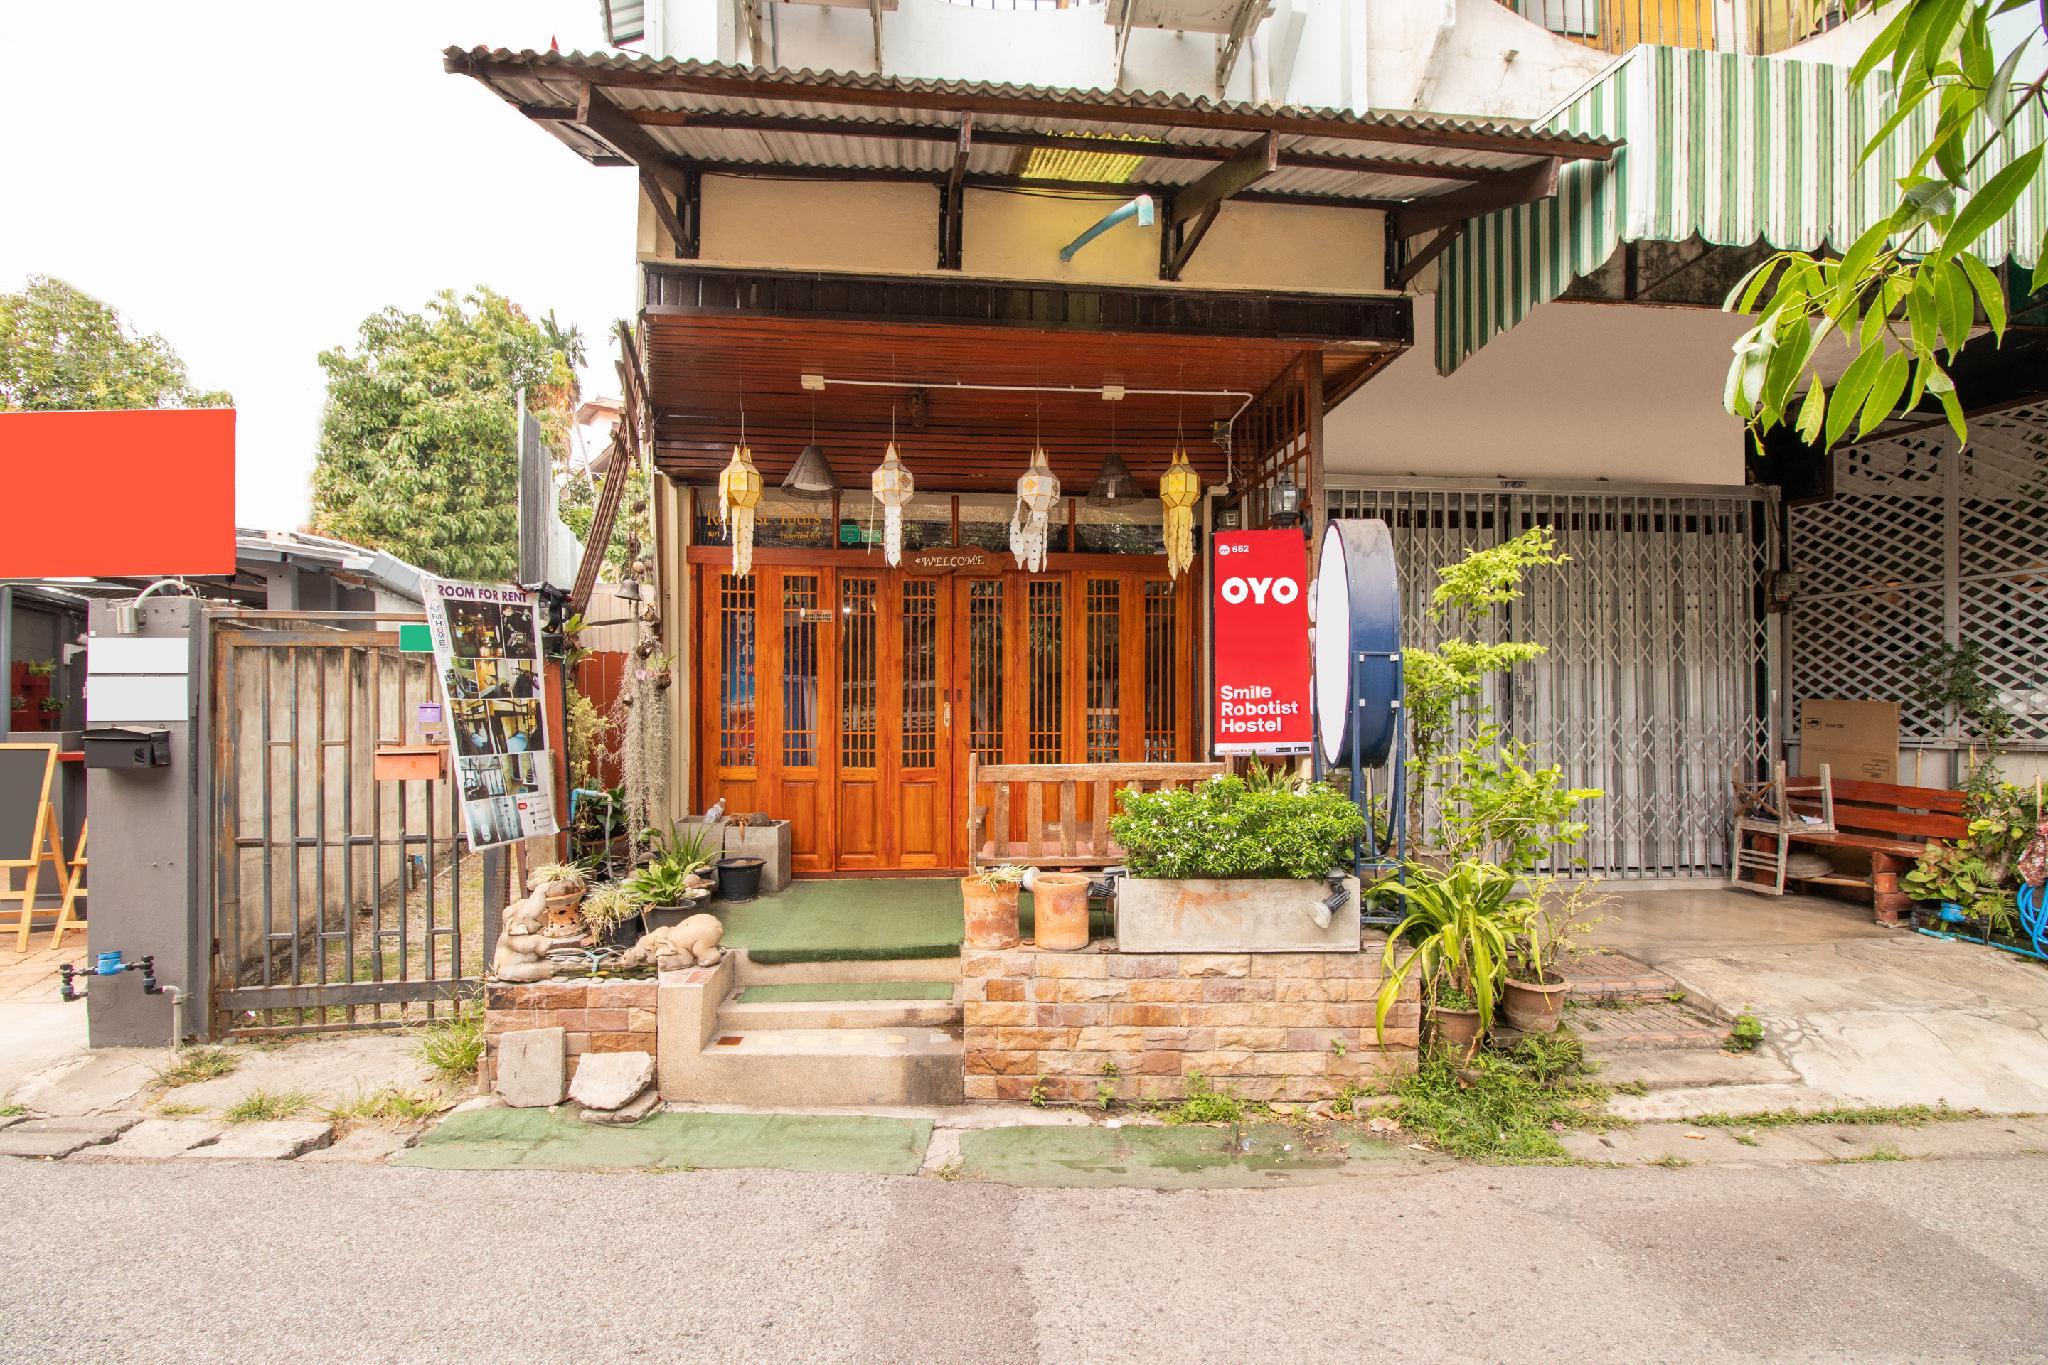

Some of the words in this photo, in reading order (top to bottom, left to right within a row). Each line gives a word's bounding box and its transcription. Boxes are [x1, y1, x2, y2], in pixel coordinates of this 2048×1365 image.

[921, 555, 985, 567] WELCOME
[437, 585, 475, 599] ROOM
[478, 589, 499, 601] FOR
[501, 592, 527, 603] RENT
[1221, 576, 1299, 605] OYO
[1221, 685, 1272, 701] Smile
[1221, 700, 1299, 716] Robotist
[1221, 717, 1282, 734] Hostel
